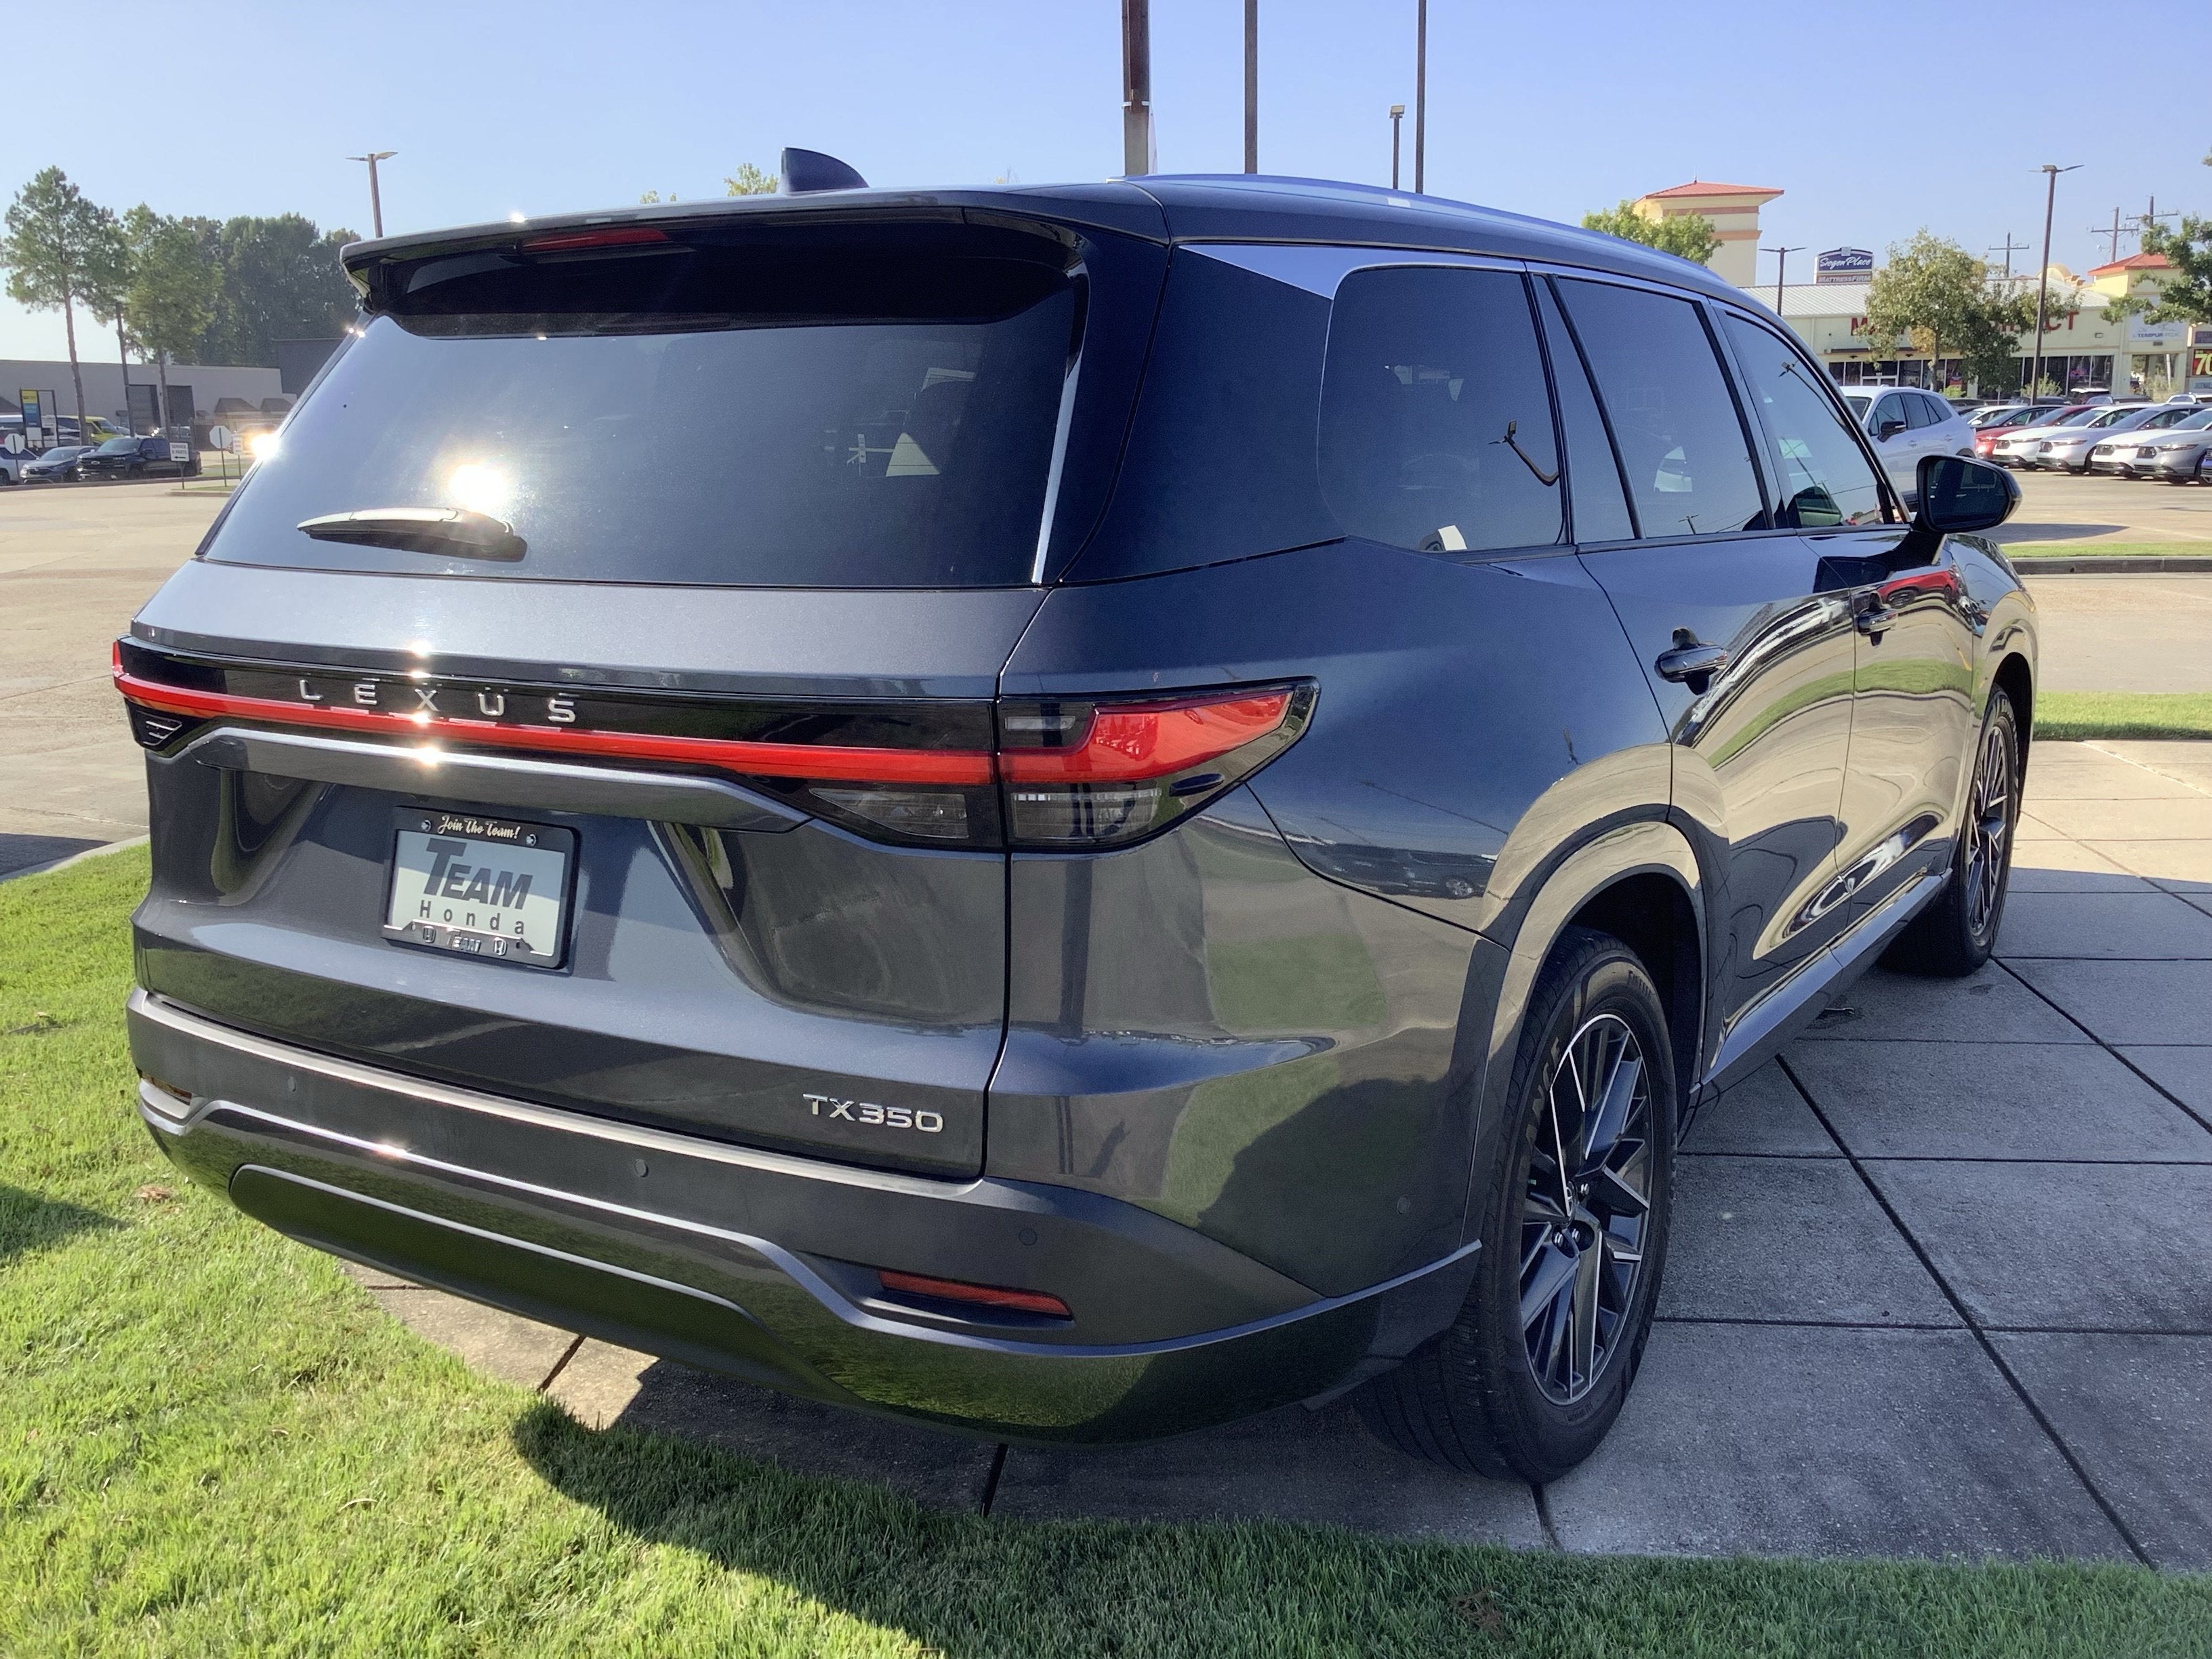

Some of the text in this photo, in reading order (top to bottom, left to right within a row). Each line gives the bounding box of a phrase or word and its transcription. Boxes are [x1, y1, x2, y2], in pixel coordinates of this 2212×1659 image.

[299, 678, 577, 724] LEXUS
[436, 815, 521, 839] Join The Team!
[423, 838, 533, 910] TEAM
[419, 899, 525, 935] Honda
